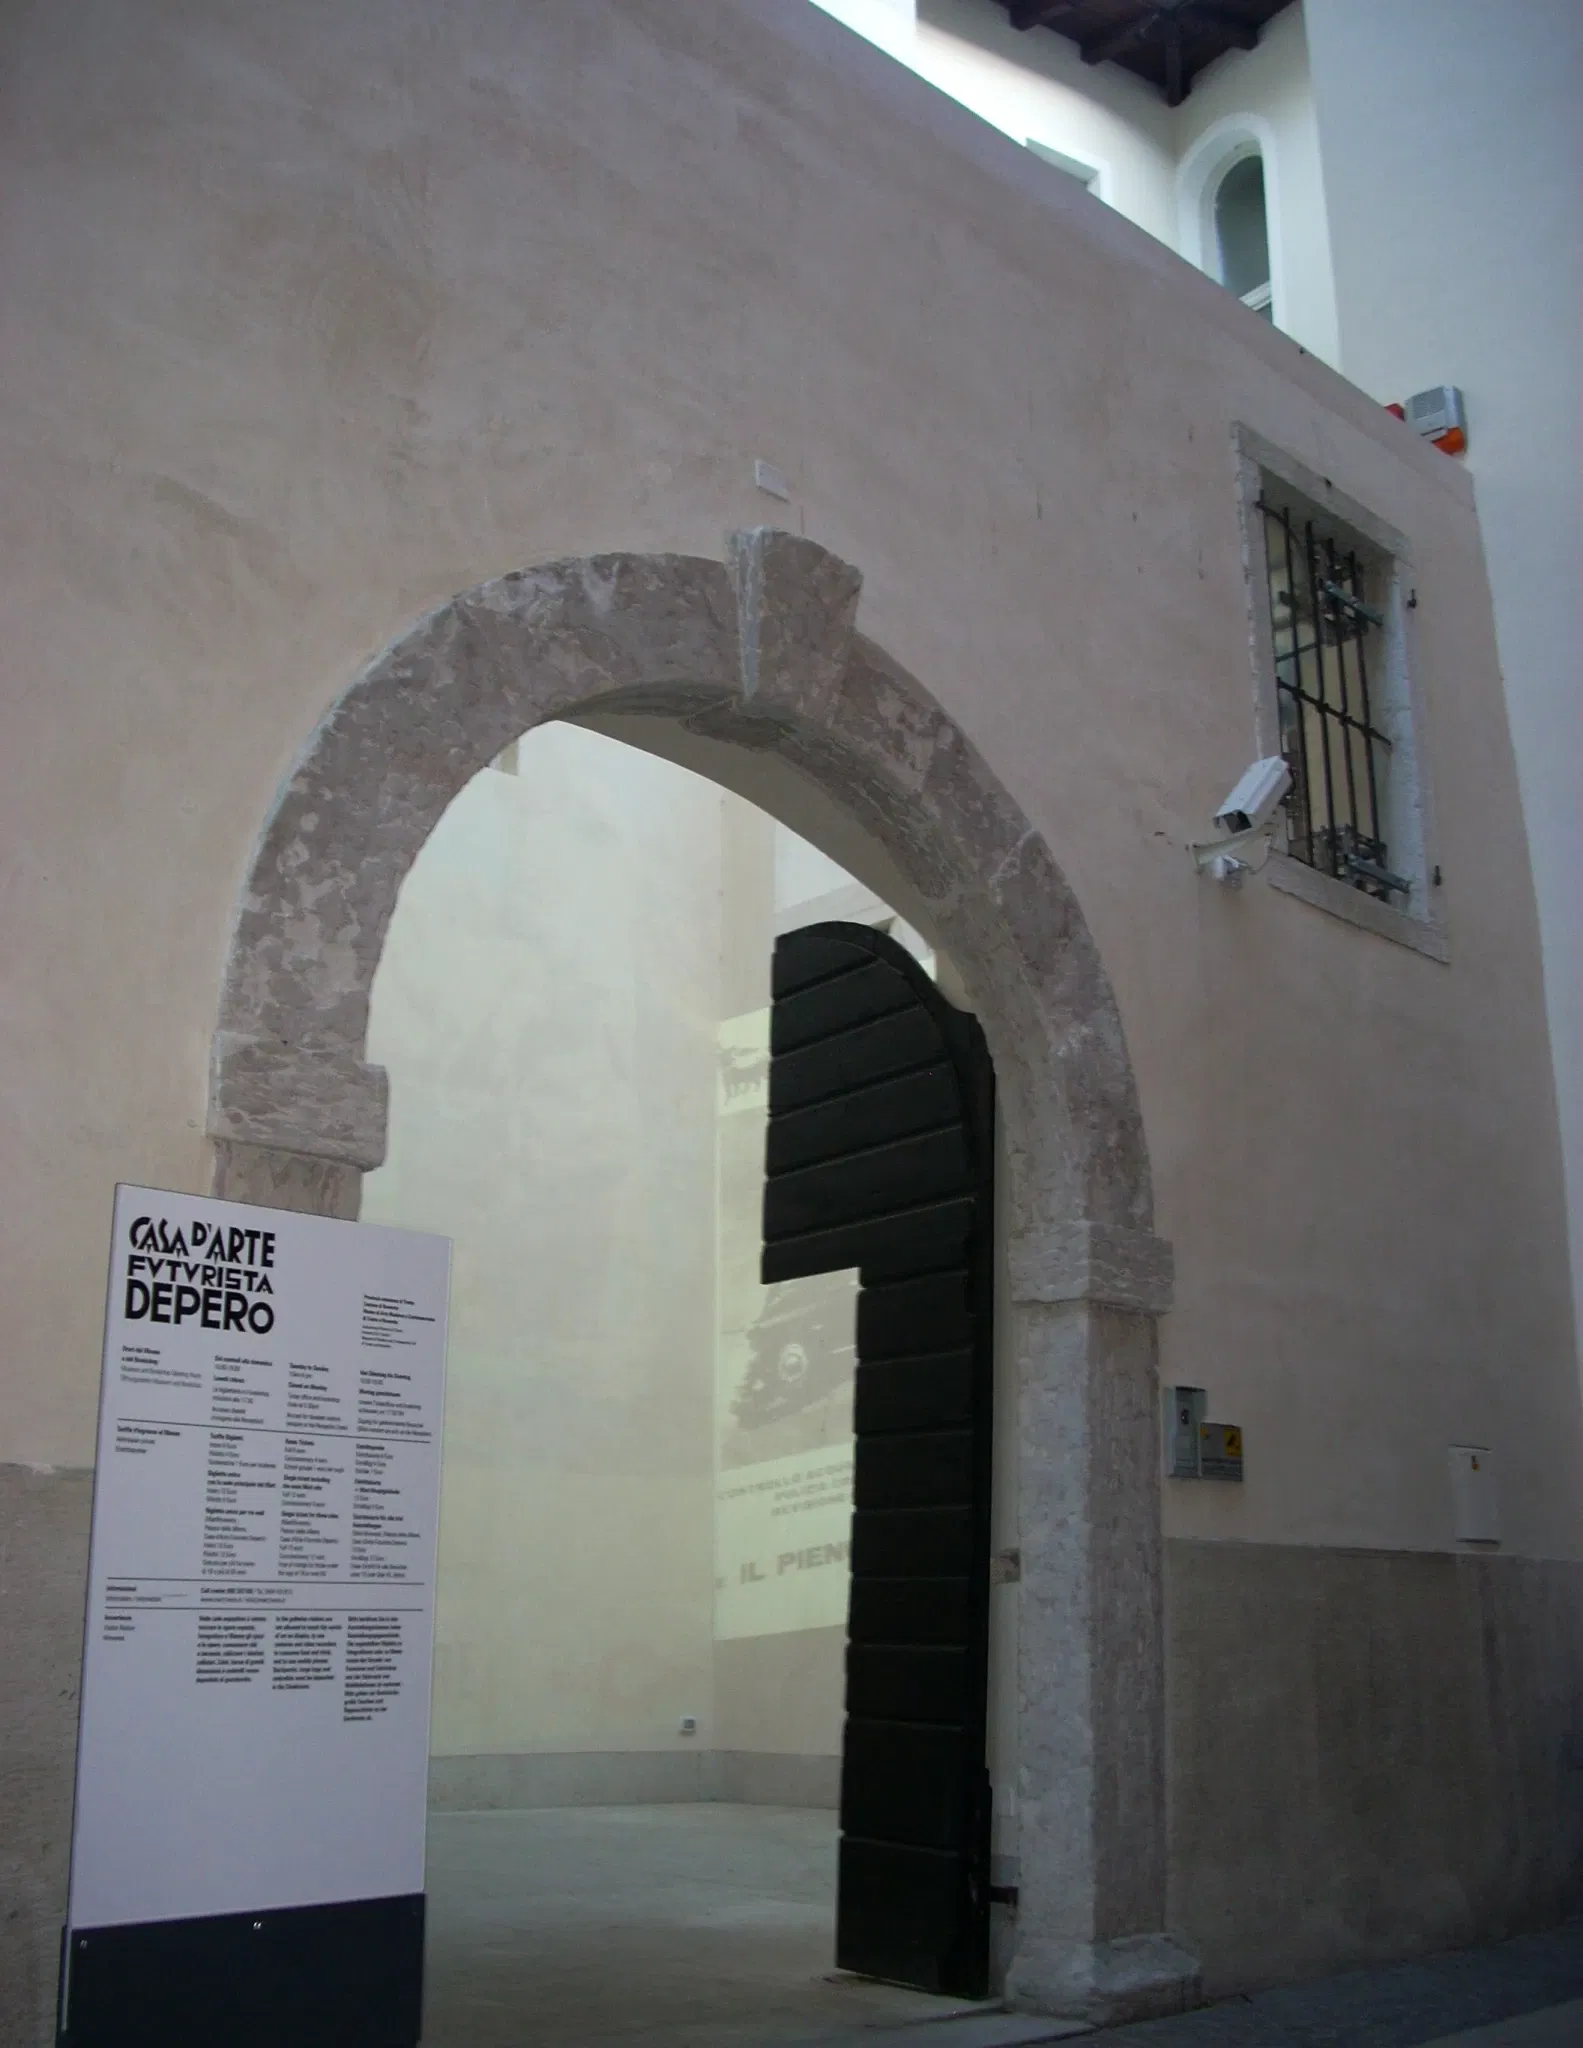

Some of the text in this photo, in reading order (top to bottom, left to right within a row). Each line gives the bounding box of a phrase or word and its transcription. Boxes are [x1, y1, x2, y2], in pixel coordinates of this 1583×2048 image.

[129, 1216, 275, 1268] CASA D'ARTE
[125, 1278, 275, 1335] DEPERO
[740, 1562, 766, 1585] IL
